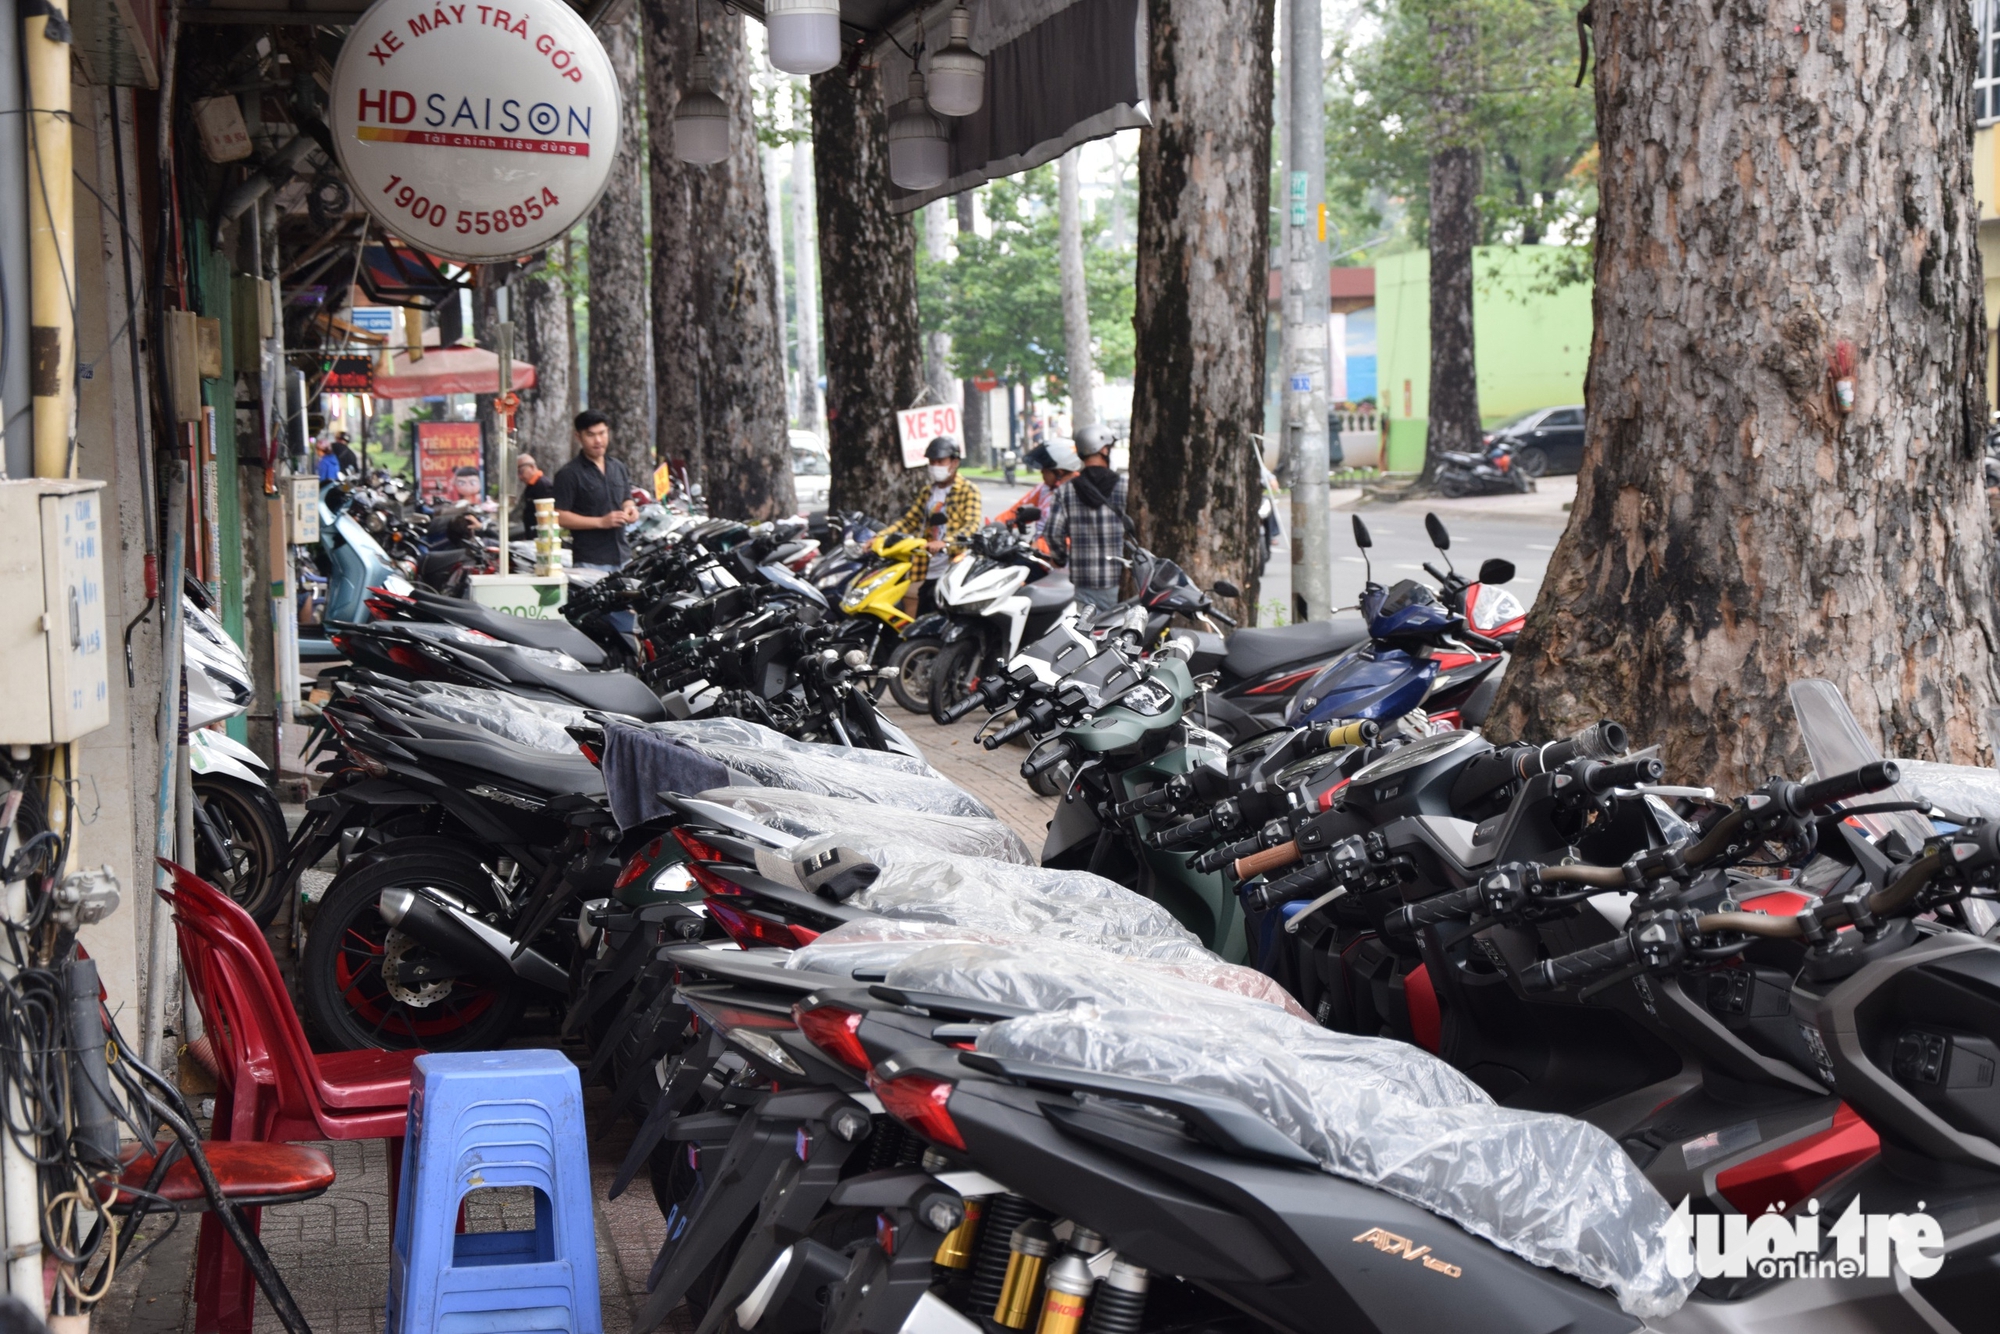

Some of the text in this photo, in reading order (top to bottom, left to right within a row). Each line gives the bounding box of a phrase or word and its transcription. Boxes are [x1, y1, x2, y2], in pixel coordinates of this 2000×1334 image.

[368, 1, 583, 84] XE MÁY TRẢ GÓP
[358, 88, 591, 139] HD SAISON
[423, 133, 577, 155] Tài chính tiêu dùng
[382, 174, 559, 235] 1900 558854
[905, 407, 956, 440] XE 50
